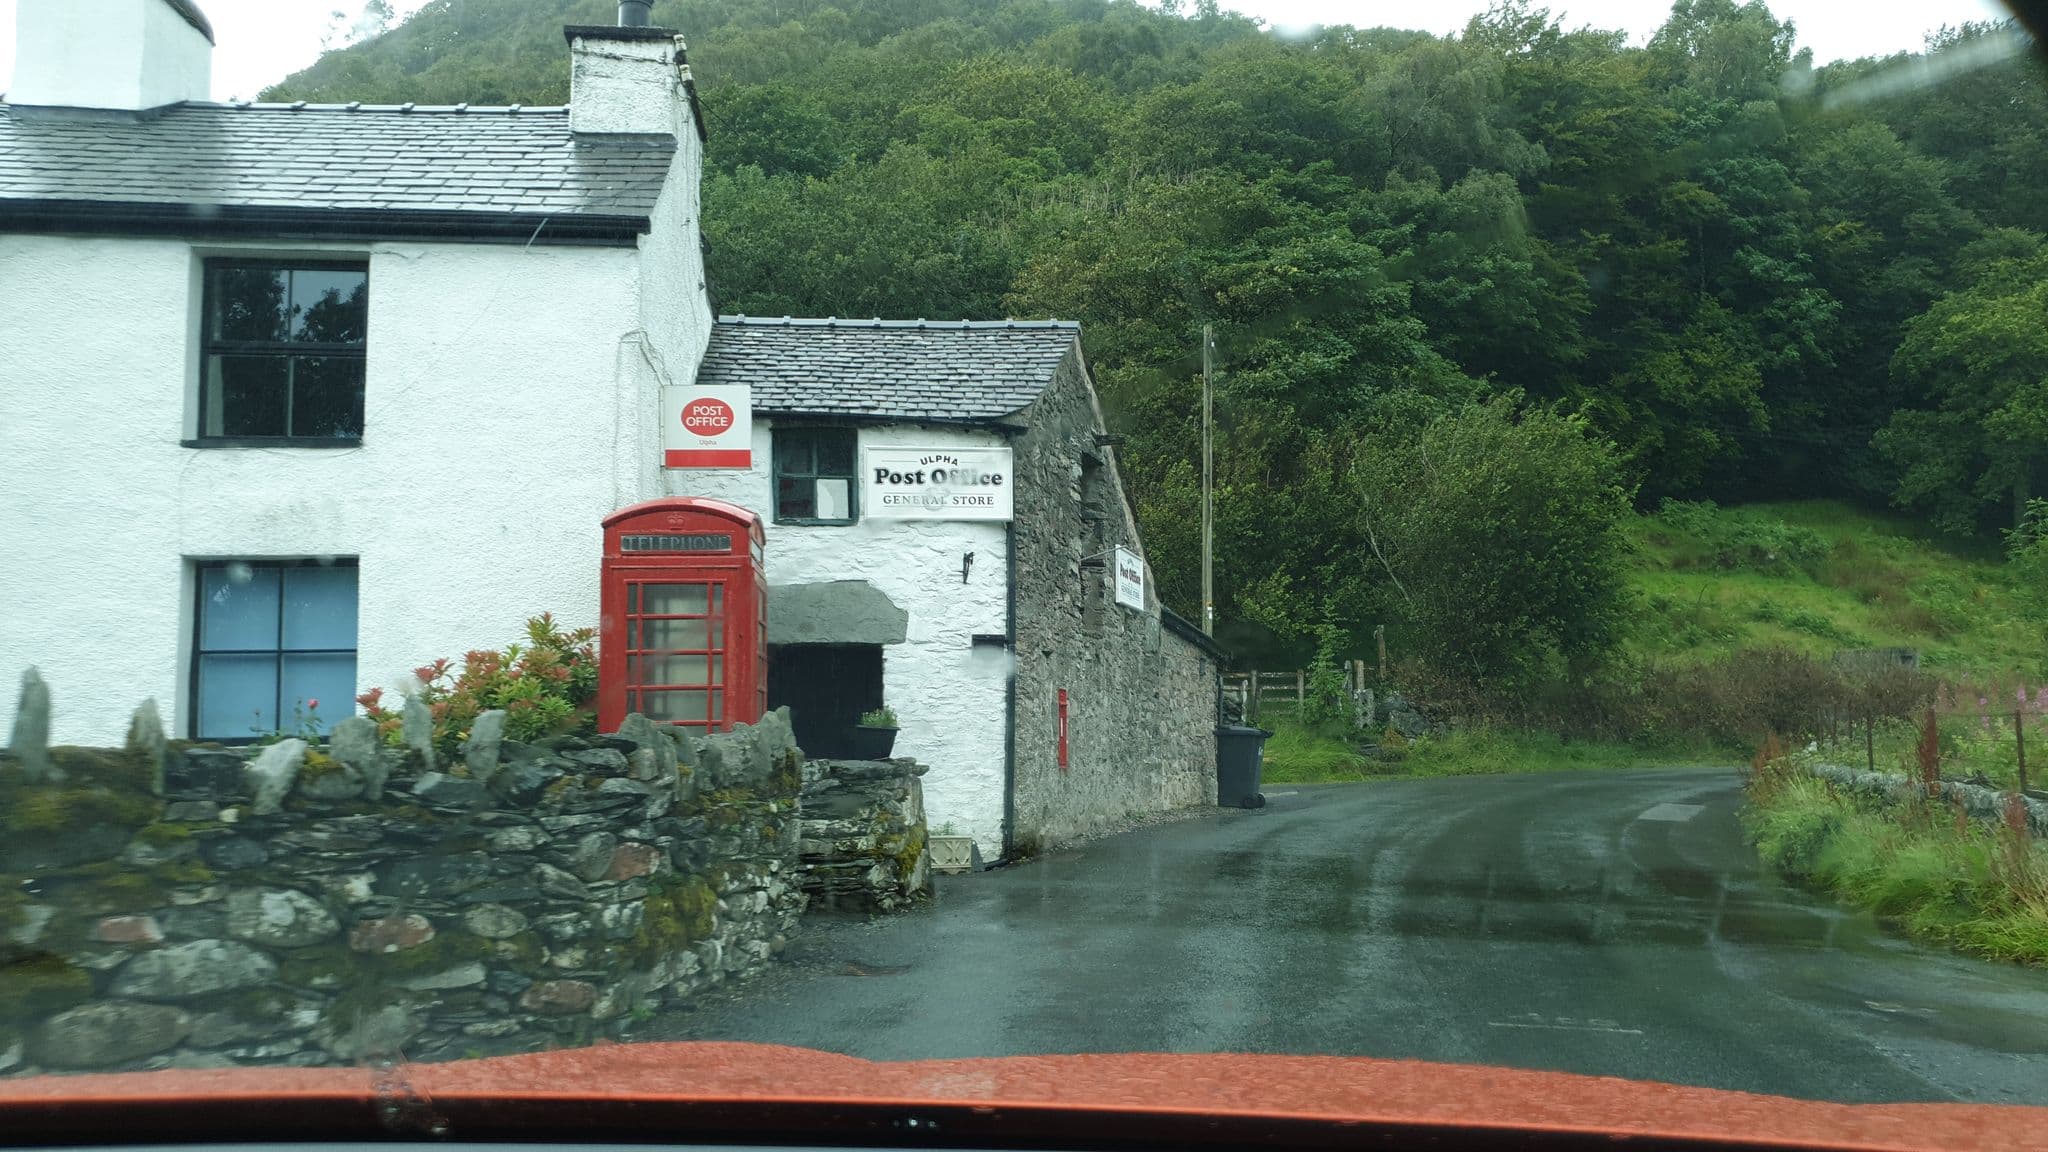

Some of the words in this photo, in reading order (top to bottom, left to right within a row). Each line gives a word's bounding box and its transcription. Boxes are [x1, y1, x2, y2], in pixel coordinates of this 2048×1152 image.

[693, 406, 724, 416] POST
[686, 416, 728, 427] OFFICE
[920, 455, 959, 466] ULPHA
[875, 467, 925, 485] Post
[931, 468, 1003, 485] Office
[883, 495, 948, 505] GENERAL
[952, 496, 994, 505] STORE
[627, 536, 727, 550] TELEPHONE
